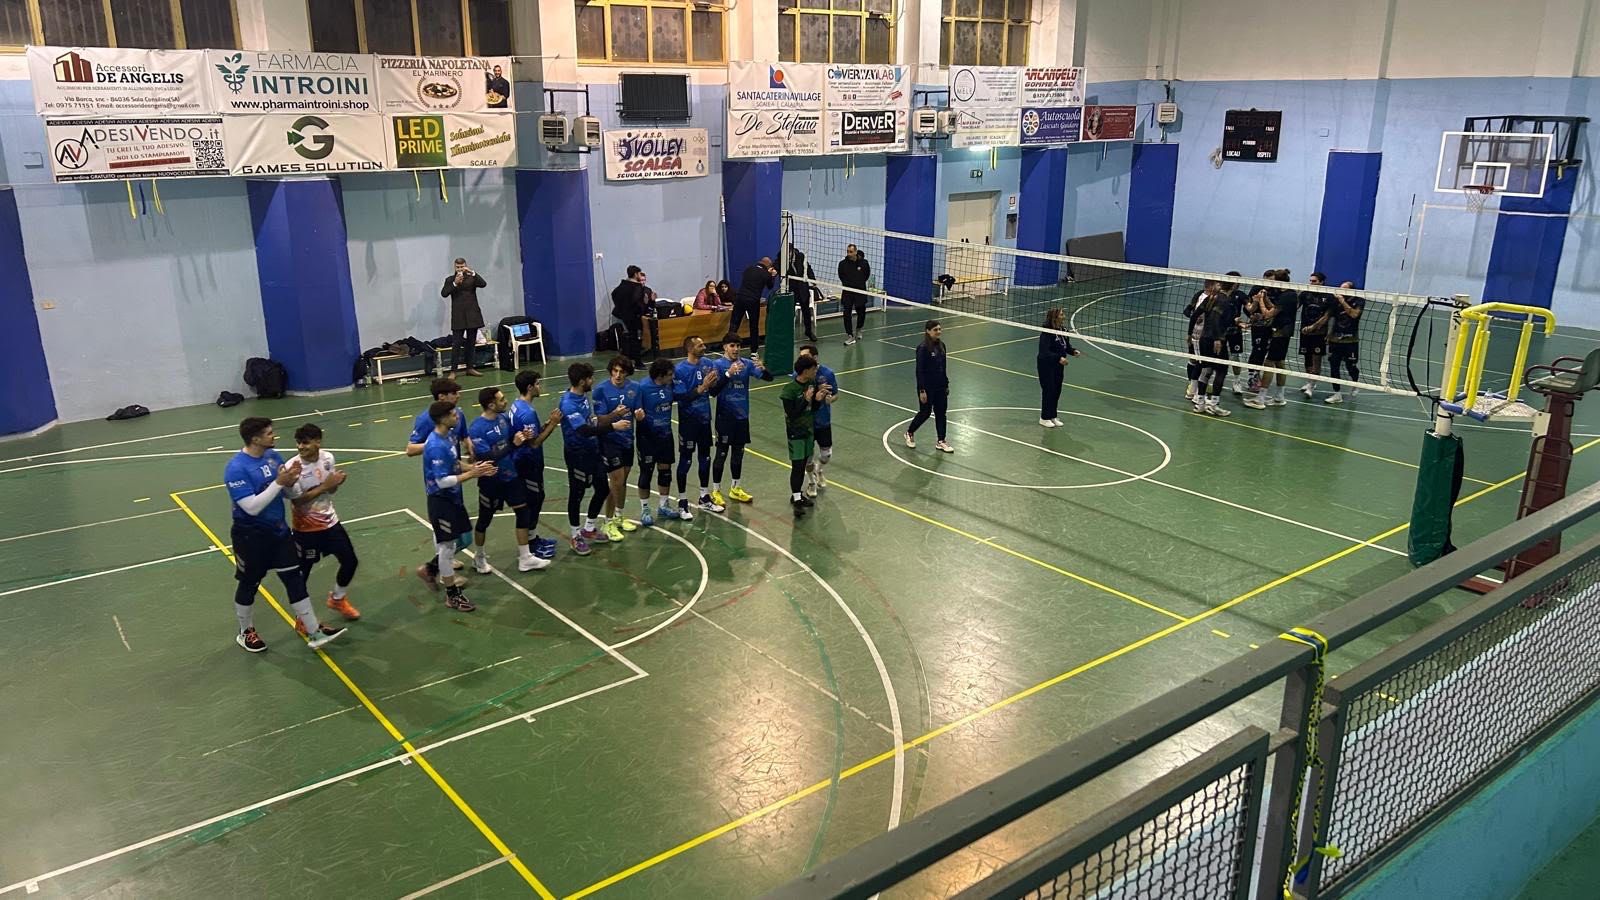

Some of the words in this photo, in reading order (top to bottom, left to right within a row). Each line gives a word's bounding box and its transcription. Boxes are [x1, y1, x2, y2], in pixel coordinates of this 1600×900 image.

[95, 63, 146, 73] Accessori
[256, 53, 360, 71] FARMACIA
[380, 58, 426, 69] PIZZERIA
[429, 59, 491, 71] NAPOLETANA
[96, 72, 120, 83] DE
[120, 73, 184, 84] ANGELIS
[251, 75, 369, 95] INTROINI
[736, 91, 821, 101] SANTACATERINAVILLAGE
[230, 99, 370, 111] www.pharmaintroini.shop
[844, 112, 894, 130] DERVER
[1039, 109, 1081, 121] Autoscuola
[396, 118, 440, 139] LED
[734, 111, 763, 136] De
[765, 111, 819, 140] Stefano
[399, 139, 443, 154] PRIME
[634, 138, 683, 157] VOLLEY
[242, 163, 303, 175] GAMES
[305, 161, 383, 172] SOLUTION
[624, 156, 682, 172] SCALEA
[696, 371, 702, 380] 8
[659, 390, 665, 399] 5
[494, 425, 501, 435] 4
[260, 464, 272, 478] 18
